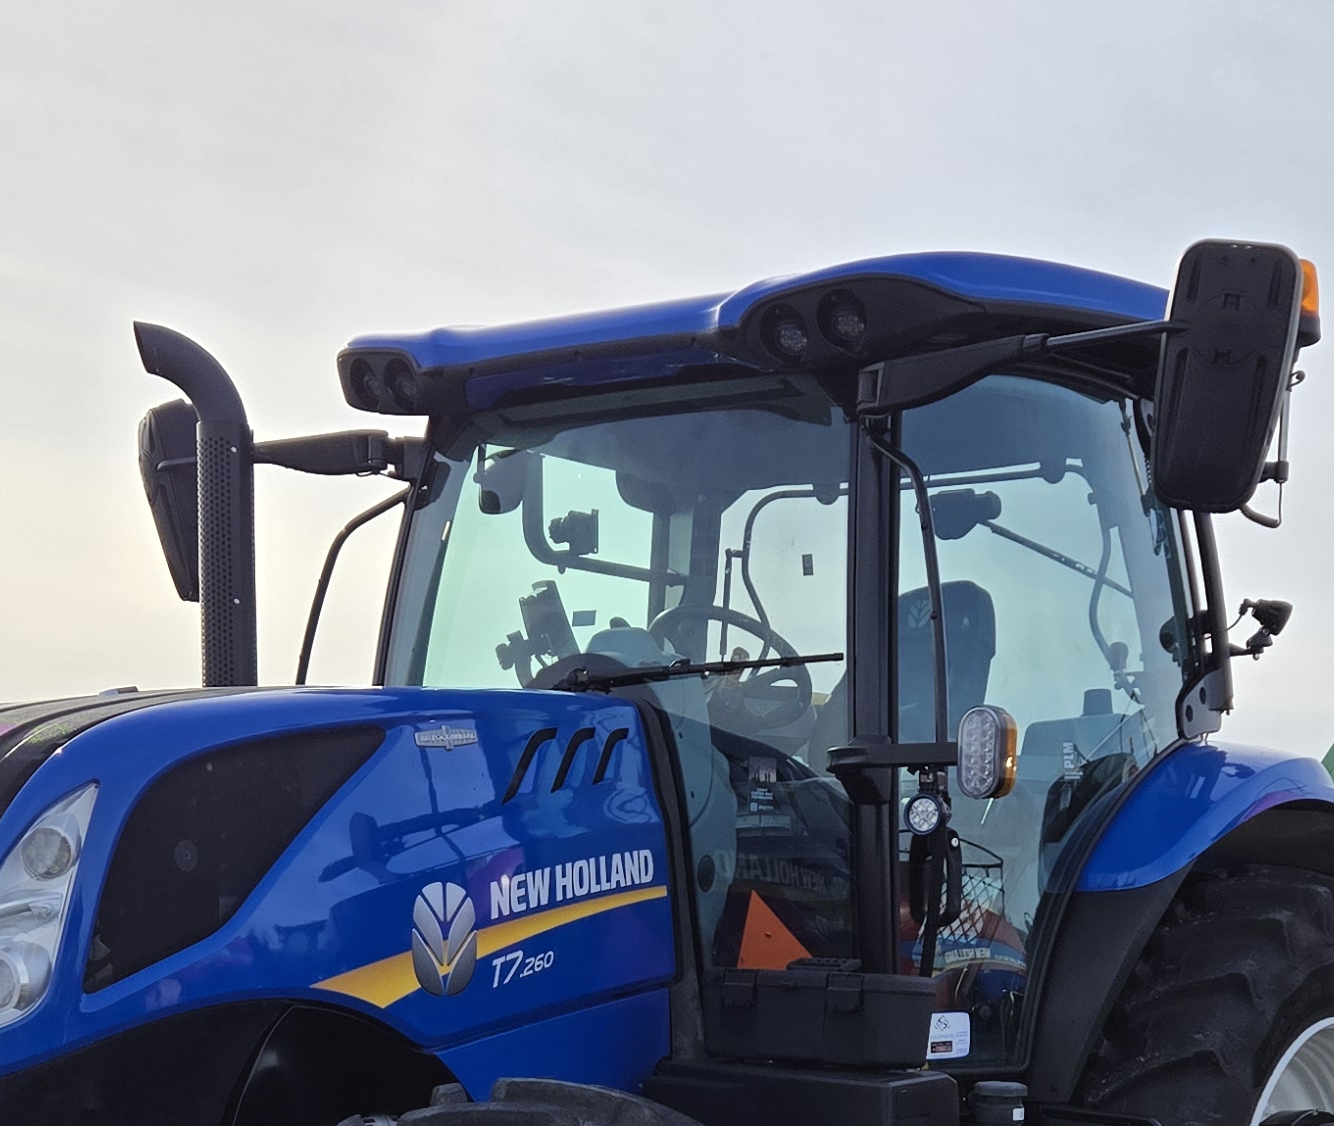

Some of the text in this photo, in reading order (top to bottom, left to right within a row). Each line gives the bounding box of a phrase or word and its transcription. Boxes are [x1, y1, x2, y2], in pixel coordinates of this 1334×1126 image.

[490, 849, 655, 920] NEW HOLLAND
[492, 950, 554, 988] T7.260
